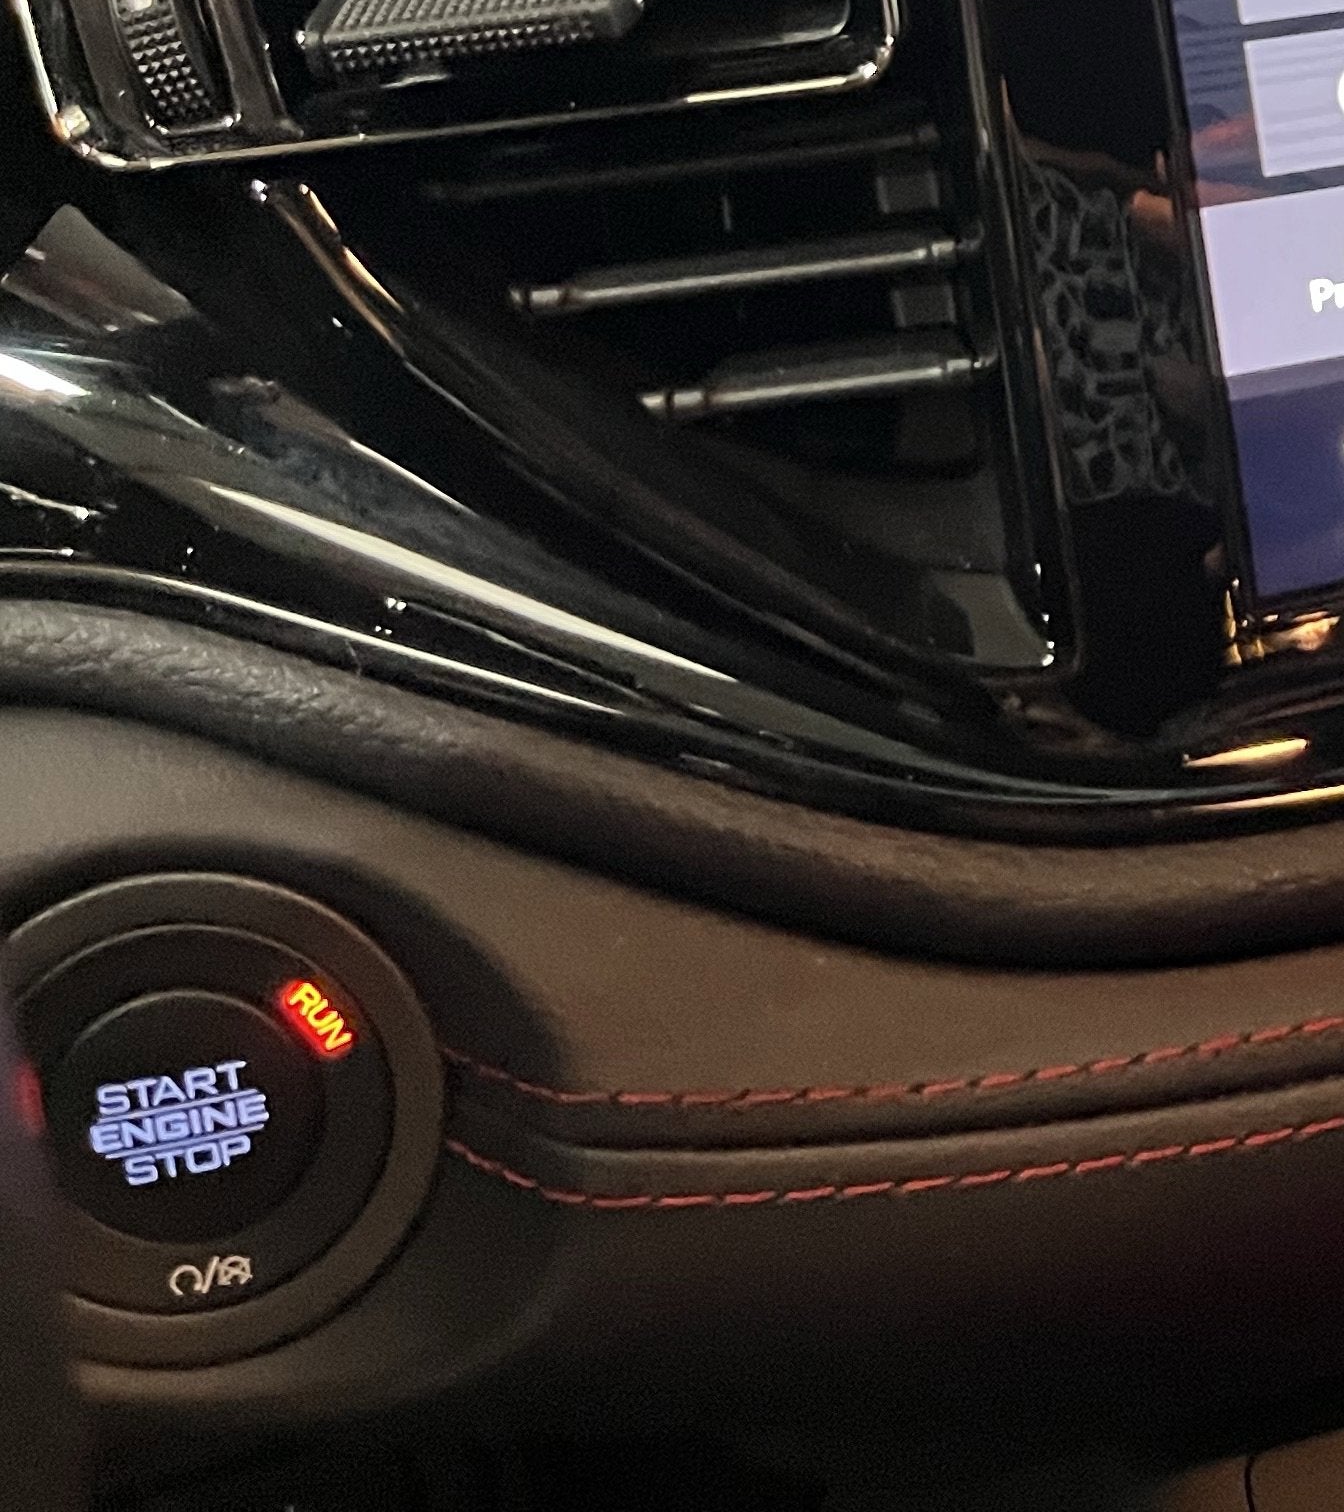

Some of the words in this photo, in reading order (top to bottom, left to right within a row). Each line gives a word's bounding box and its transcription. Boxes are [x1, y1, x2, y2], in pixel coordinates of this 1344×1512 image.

[289, 982, 352, 1051] RUN
[97, 1060, 248, 1115] START
[90, 1094, 269, 1153] ENGINE
[124, 1134, 251, 1186] STOP
